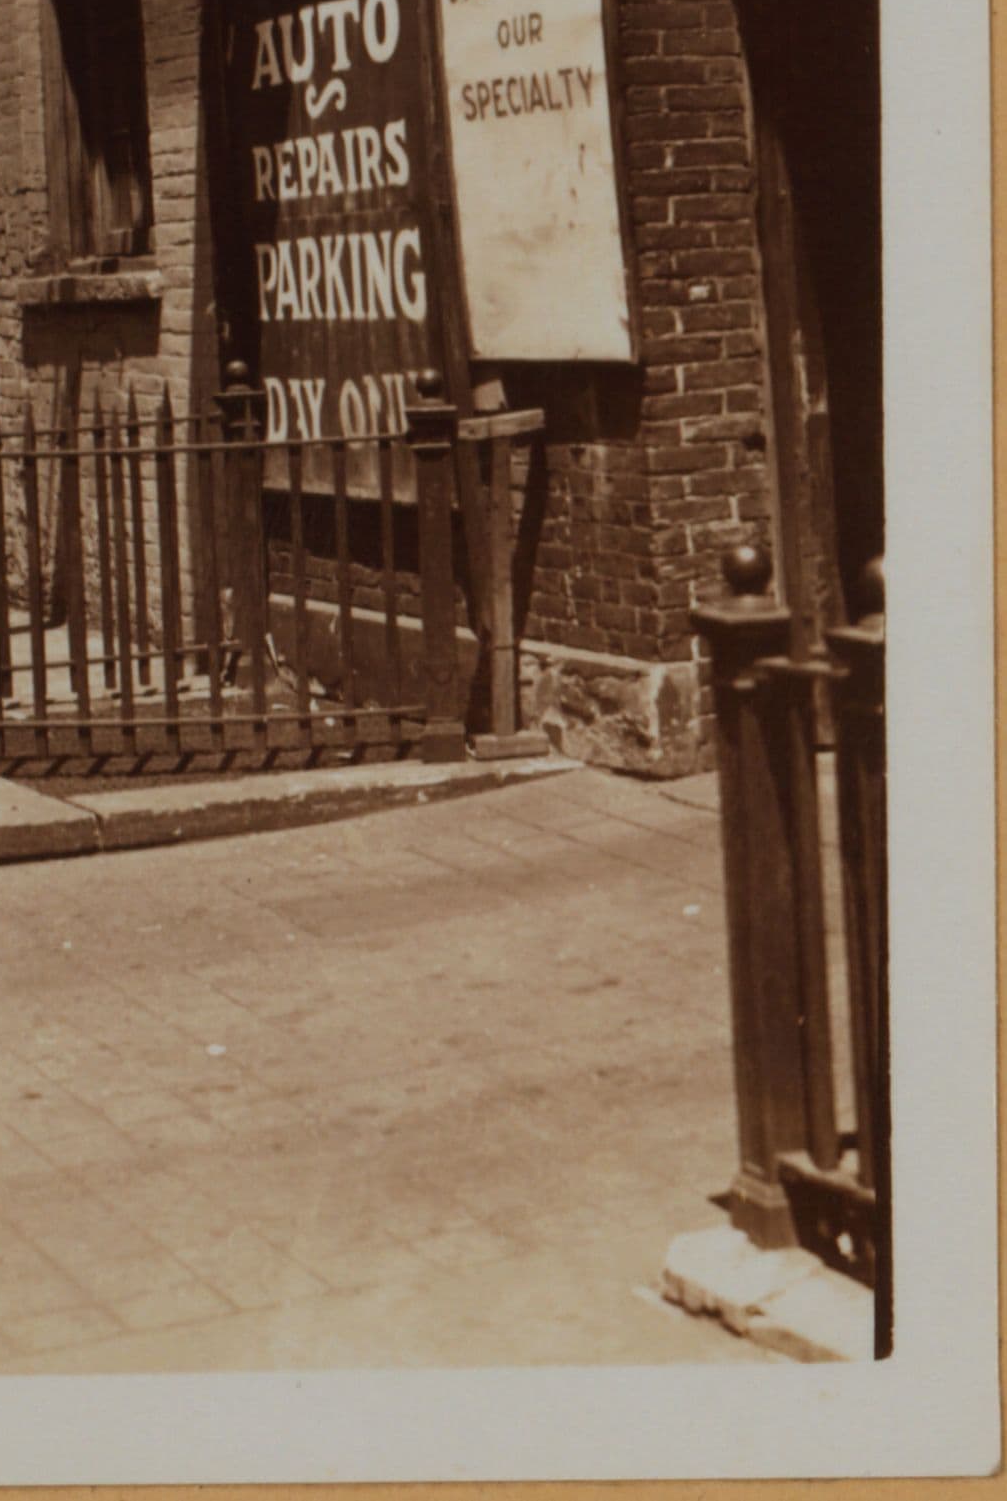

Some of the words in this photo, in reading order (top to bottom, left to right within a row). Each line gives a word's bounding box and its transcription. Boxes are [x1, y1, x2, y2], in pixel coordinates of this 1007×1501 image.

[496, 12, 543, 50] OUR
[462, 66, 594, 123] SPECIALTY
[252, 118, 410, 201] REPAIRS
[255, 227, 428, 322] PARKING
[339, 370, 419, 449] ONL
